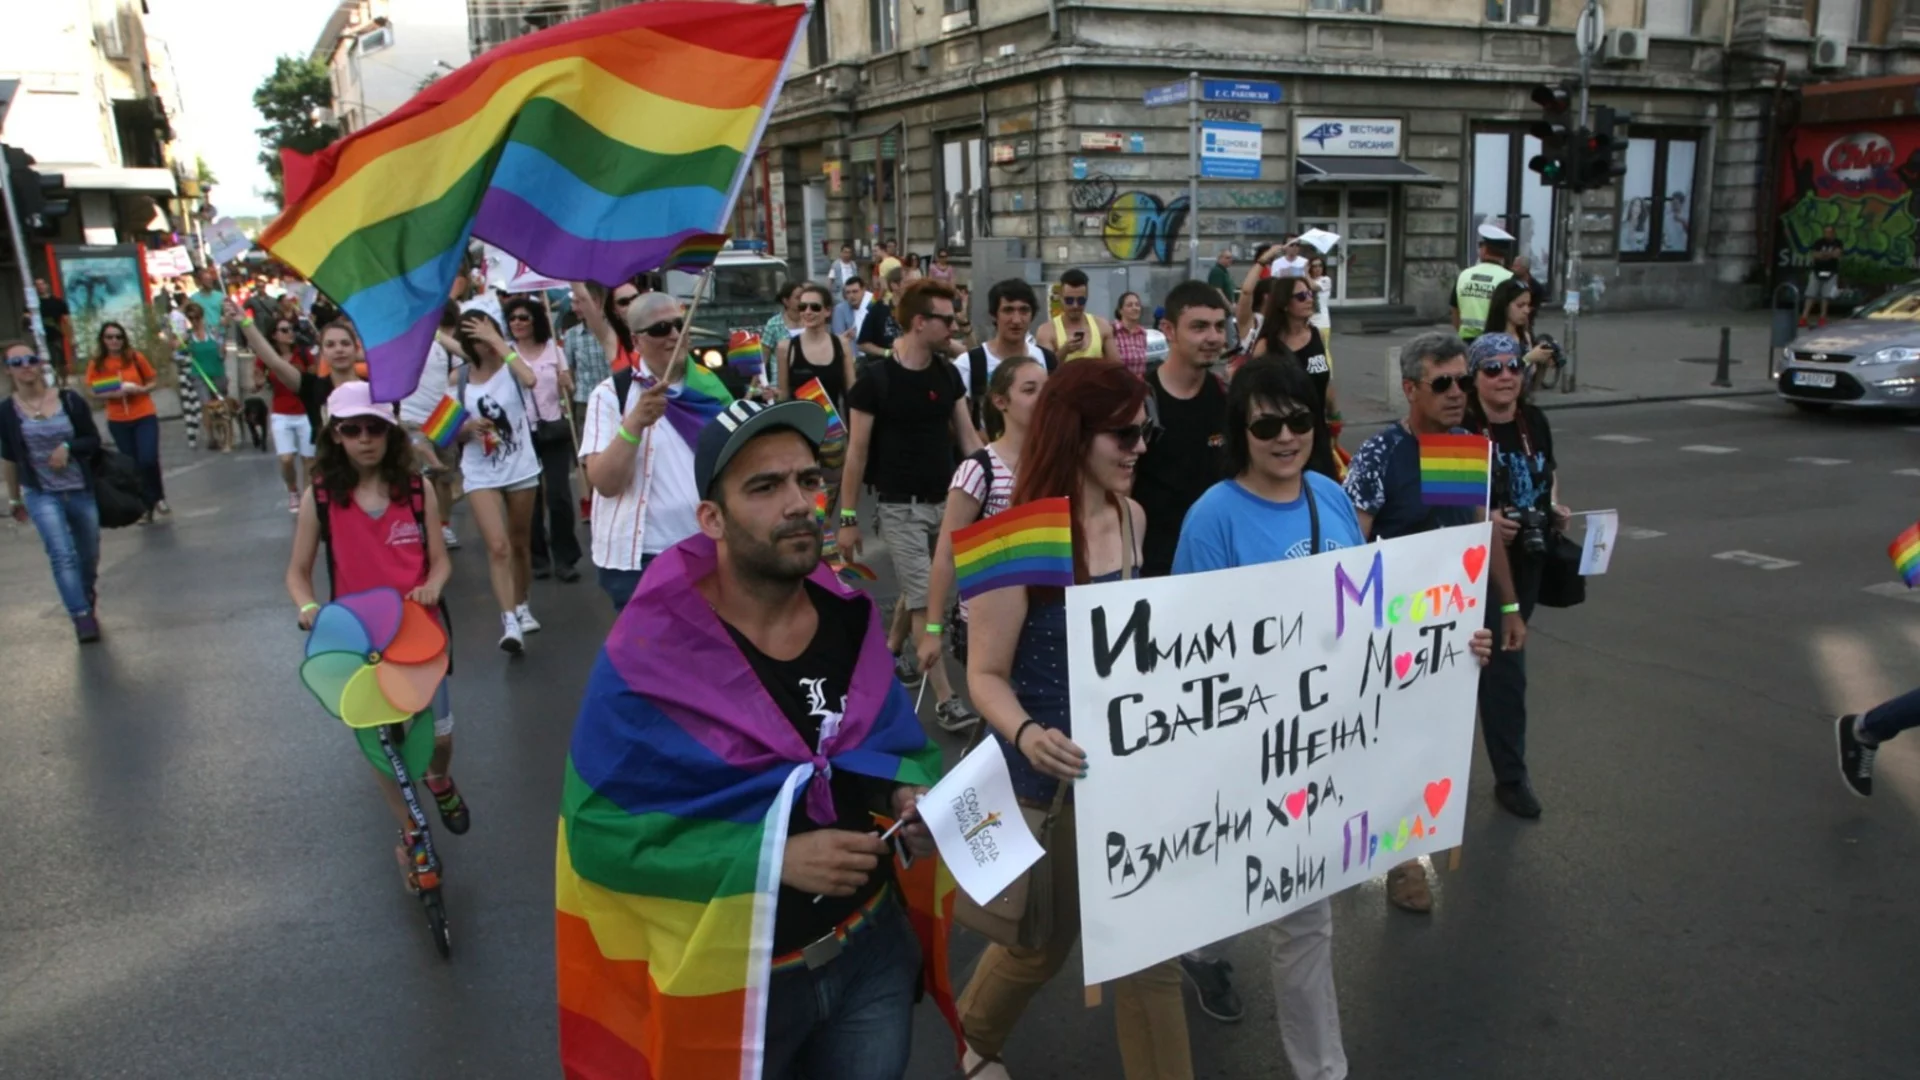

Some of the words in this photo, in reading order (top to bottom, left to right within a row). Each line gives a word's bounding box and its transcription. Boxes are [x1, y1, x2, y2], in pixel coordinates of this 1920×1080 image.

[1349, 125, 1395, 135] ВЕСТНИЦИ
[1348, 140, 1395, 149] СПИСАНИЯ
[969, 838, 990, 868] PRIDE
[979, 829, 1000, 862] SOFIA
